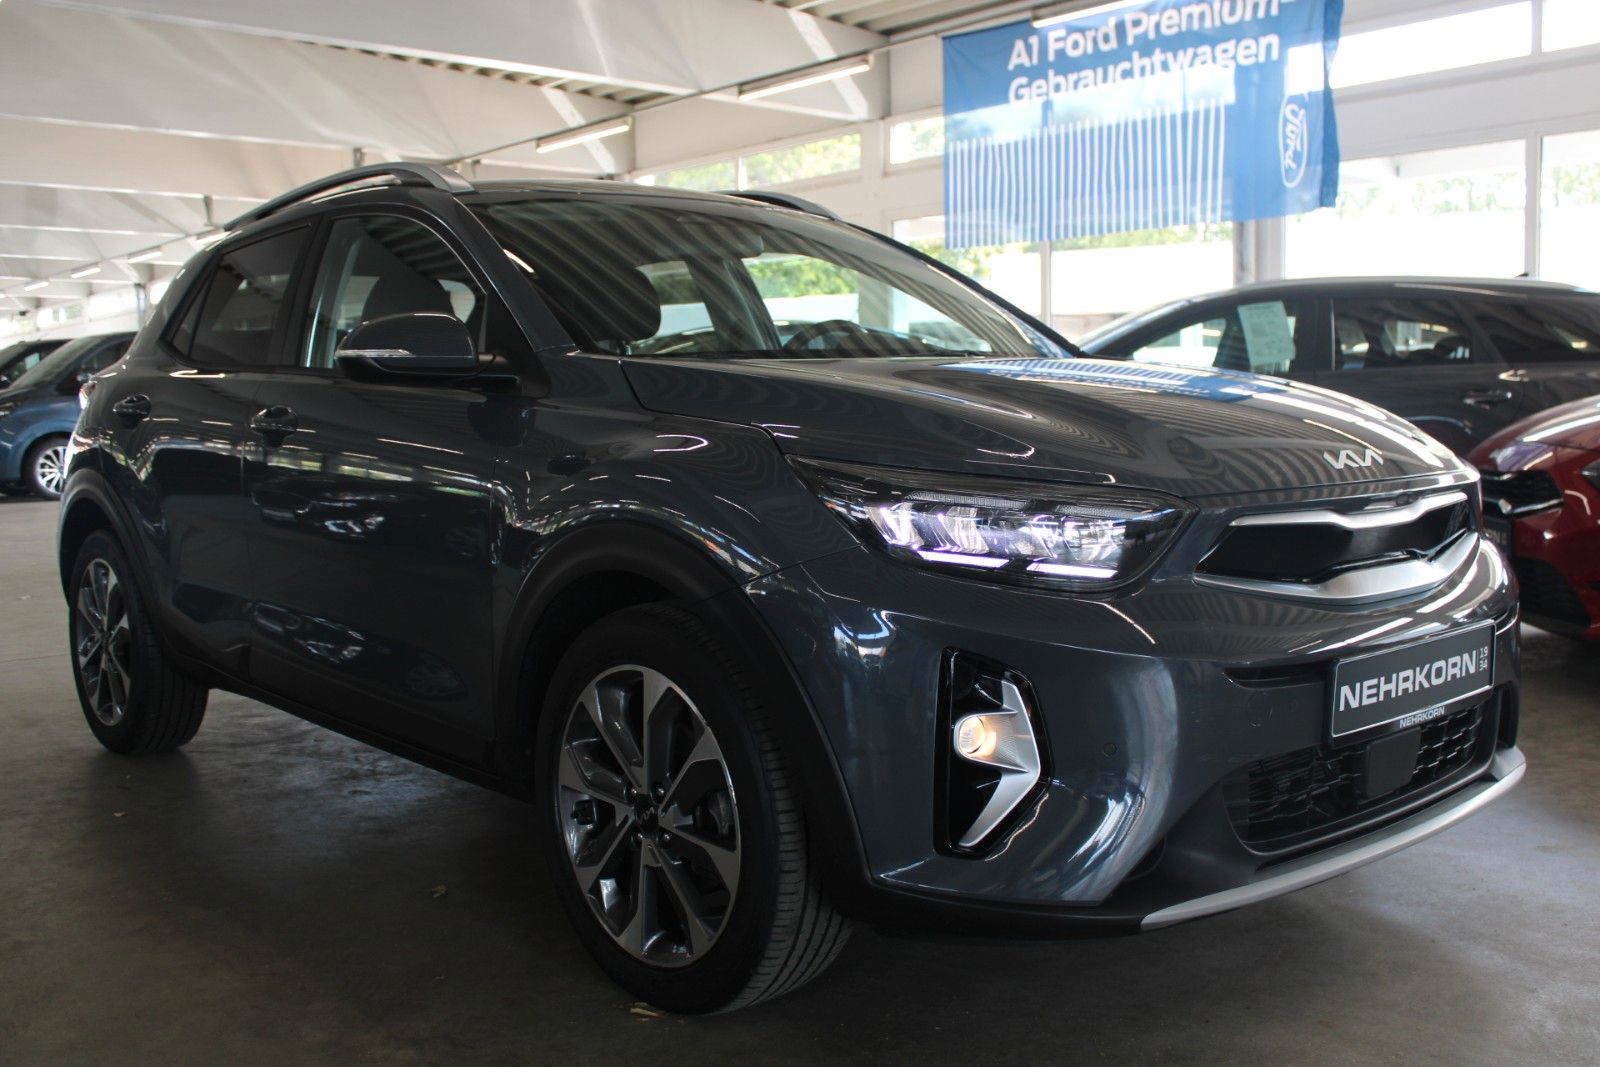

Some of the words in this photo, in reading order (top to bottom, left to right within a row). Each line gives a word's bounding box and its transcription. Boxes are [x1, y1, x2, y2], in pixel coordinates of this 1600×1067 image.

[1007, 34, 1039, 71] A1
[1047, 16, 1118, 62] Ford
[1008, 33, 1280, 105] Gebrauchtwagen
[1285, 104, 1306, 169] Ford
[1323, 448, 1384, 469] KIA
[1339, 650, 1476, 711] NEHRKORN
[1399, 705, 1445, 728] NEHRKORN
